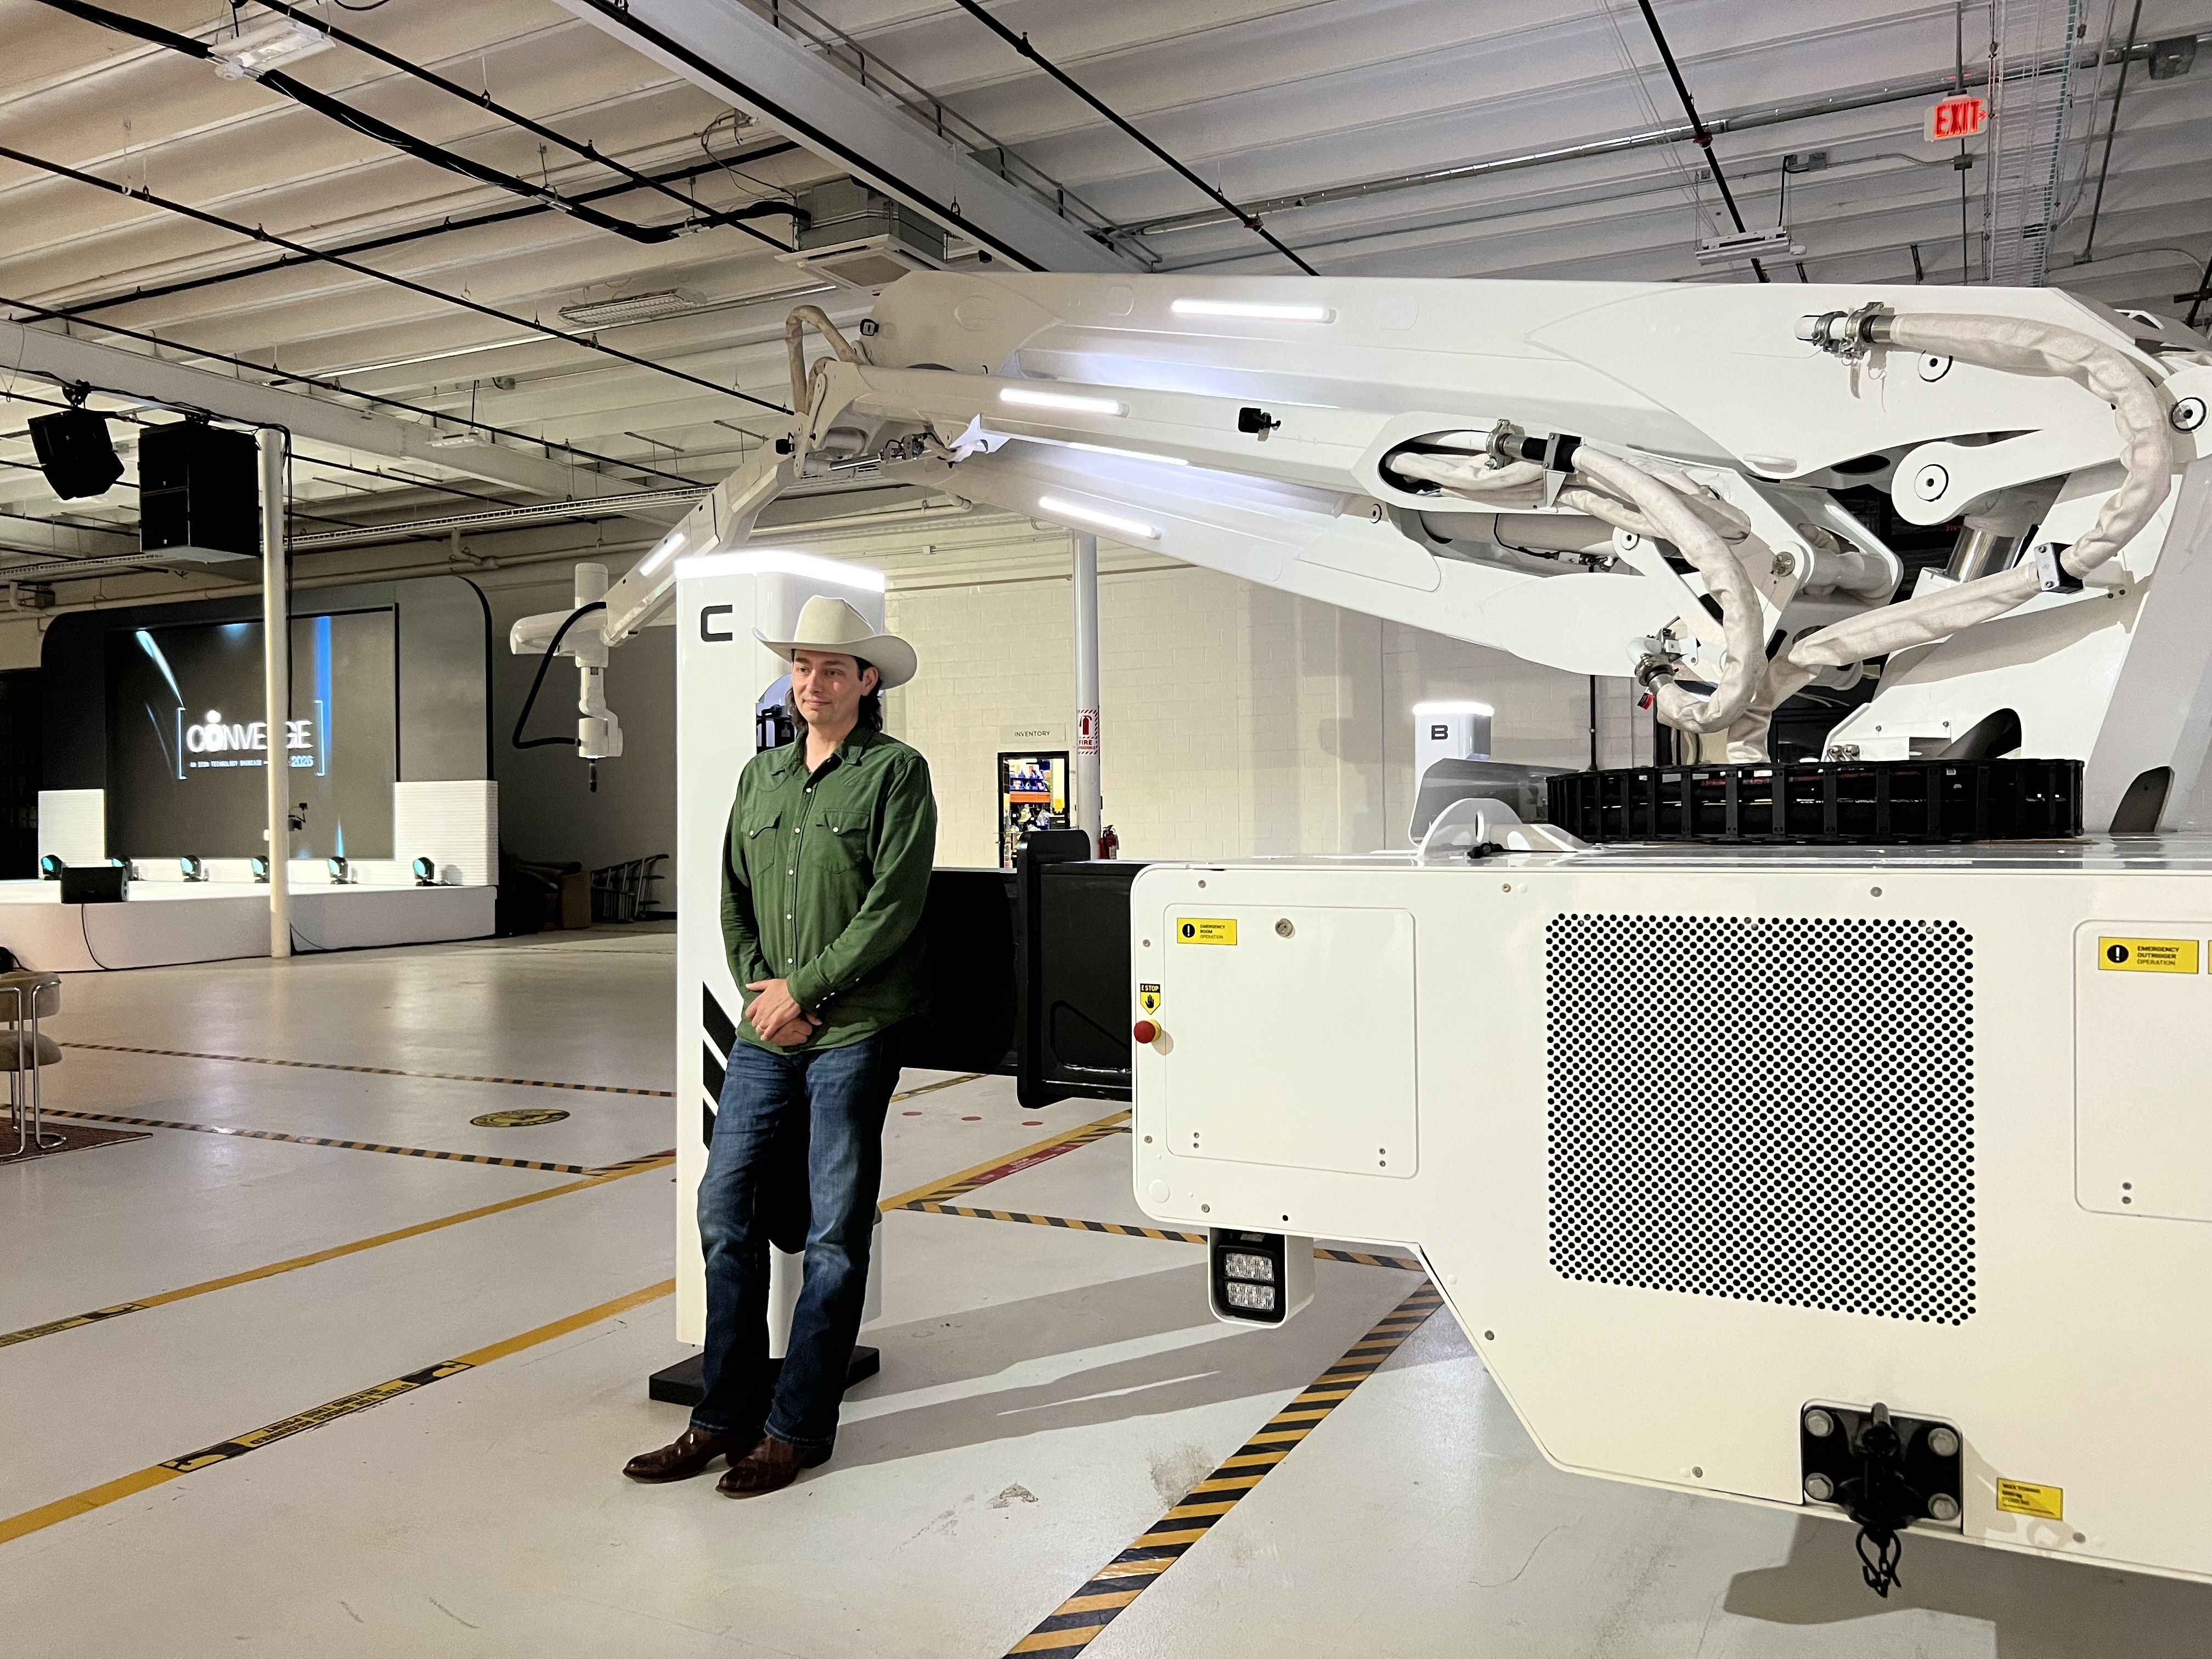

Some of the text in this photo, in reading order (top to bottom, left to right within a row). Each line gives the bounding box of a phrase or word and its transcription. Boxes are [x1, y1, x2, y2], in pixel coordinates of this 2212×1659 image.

[1934, 98, 1982, 138] EXIT
[701, 604, 733, 642] C
[187, 720, 313, 753] CONVEGE
[1431, 725, 1448, 741] B
[291, 755, 314, 768] 2026
[375, 1384, 414, 1396] STEEL
[351, 1397, 380, 1407] TOE
[249, 1420, 315, 1444] REQUIRED
